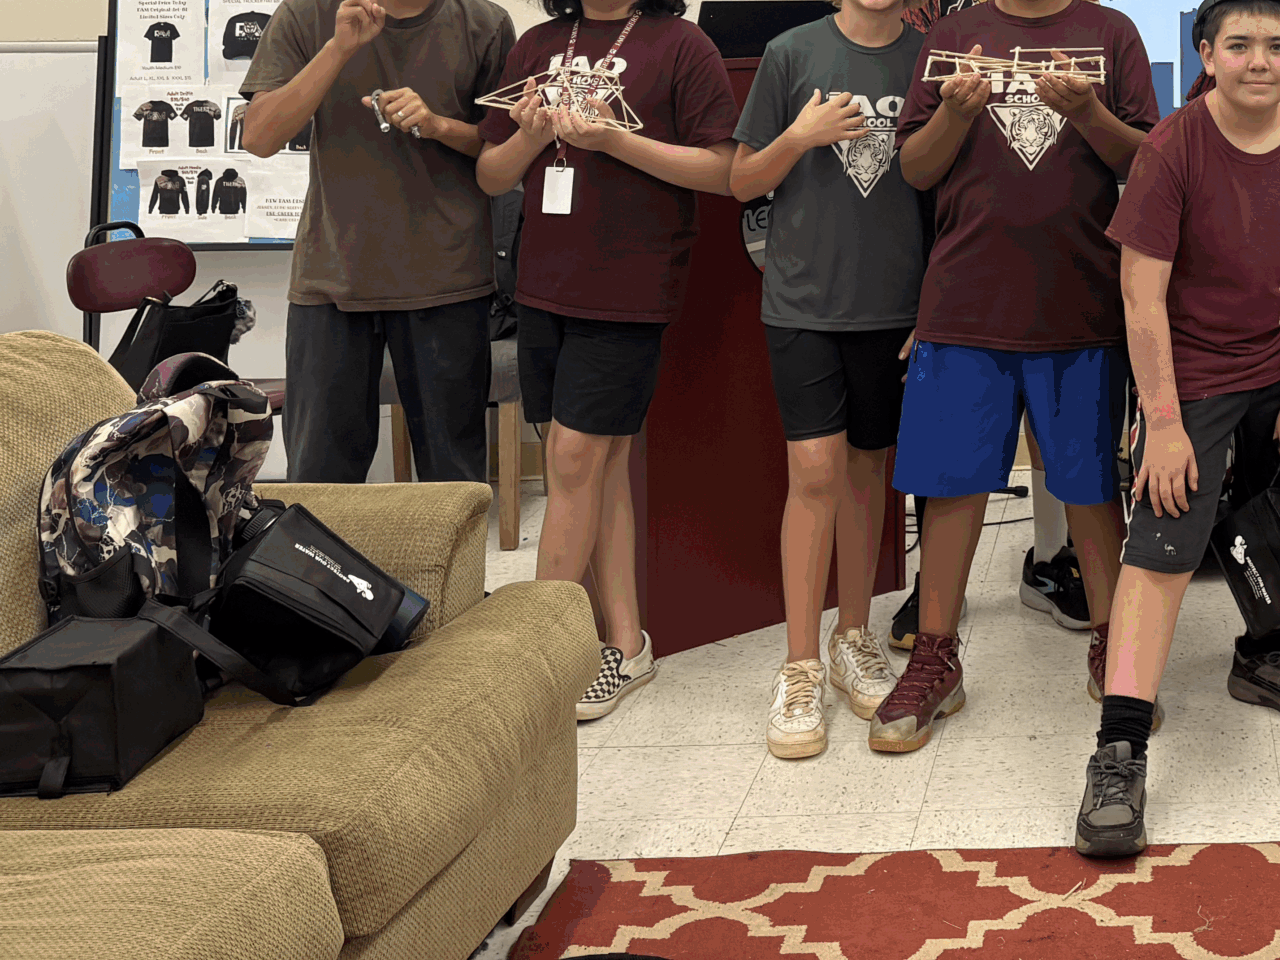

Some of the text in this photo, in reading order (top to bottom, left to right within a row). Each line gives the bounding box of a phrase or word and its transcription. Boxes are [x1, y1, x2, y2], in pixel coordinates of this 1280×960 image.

[1005, 94, 1040, 104] SCHO
[294, 543, 315, 558] WATER
[1262, 586, 1272, 605] WATER
